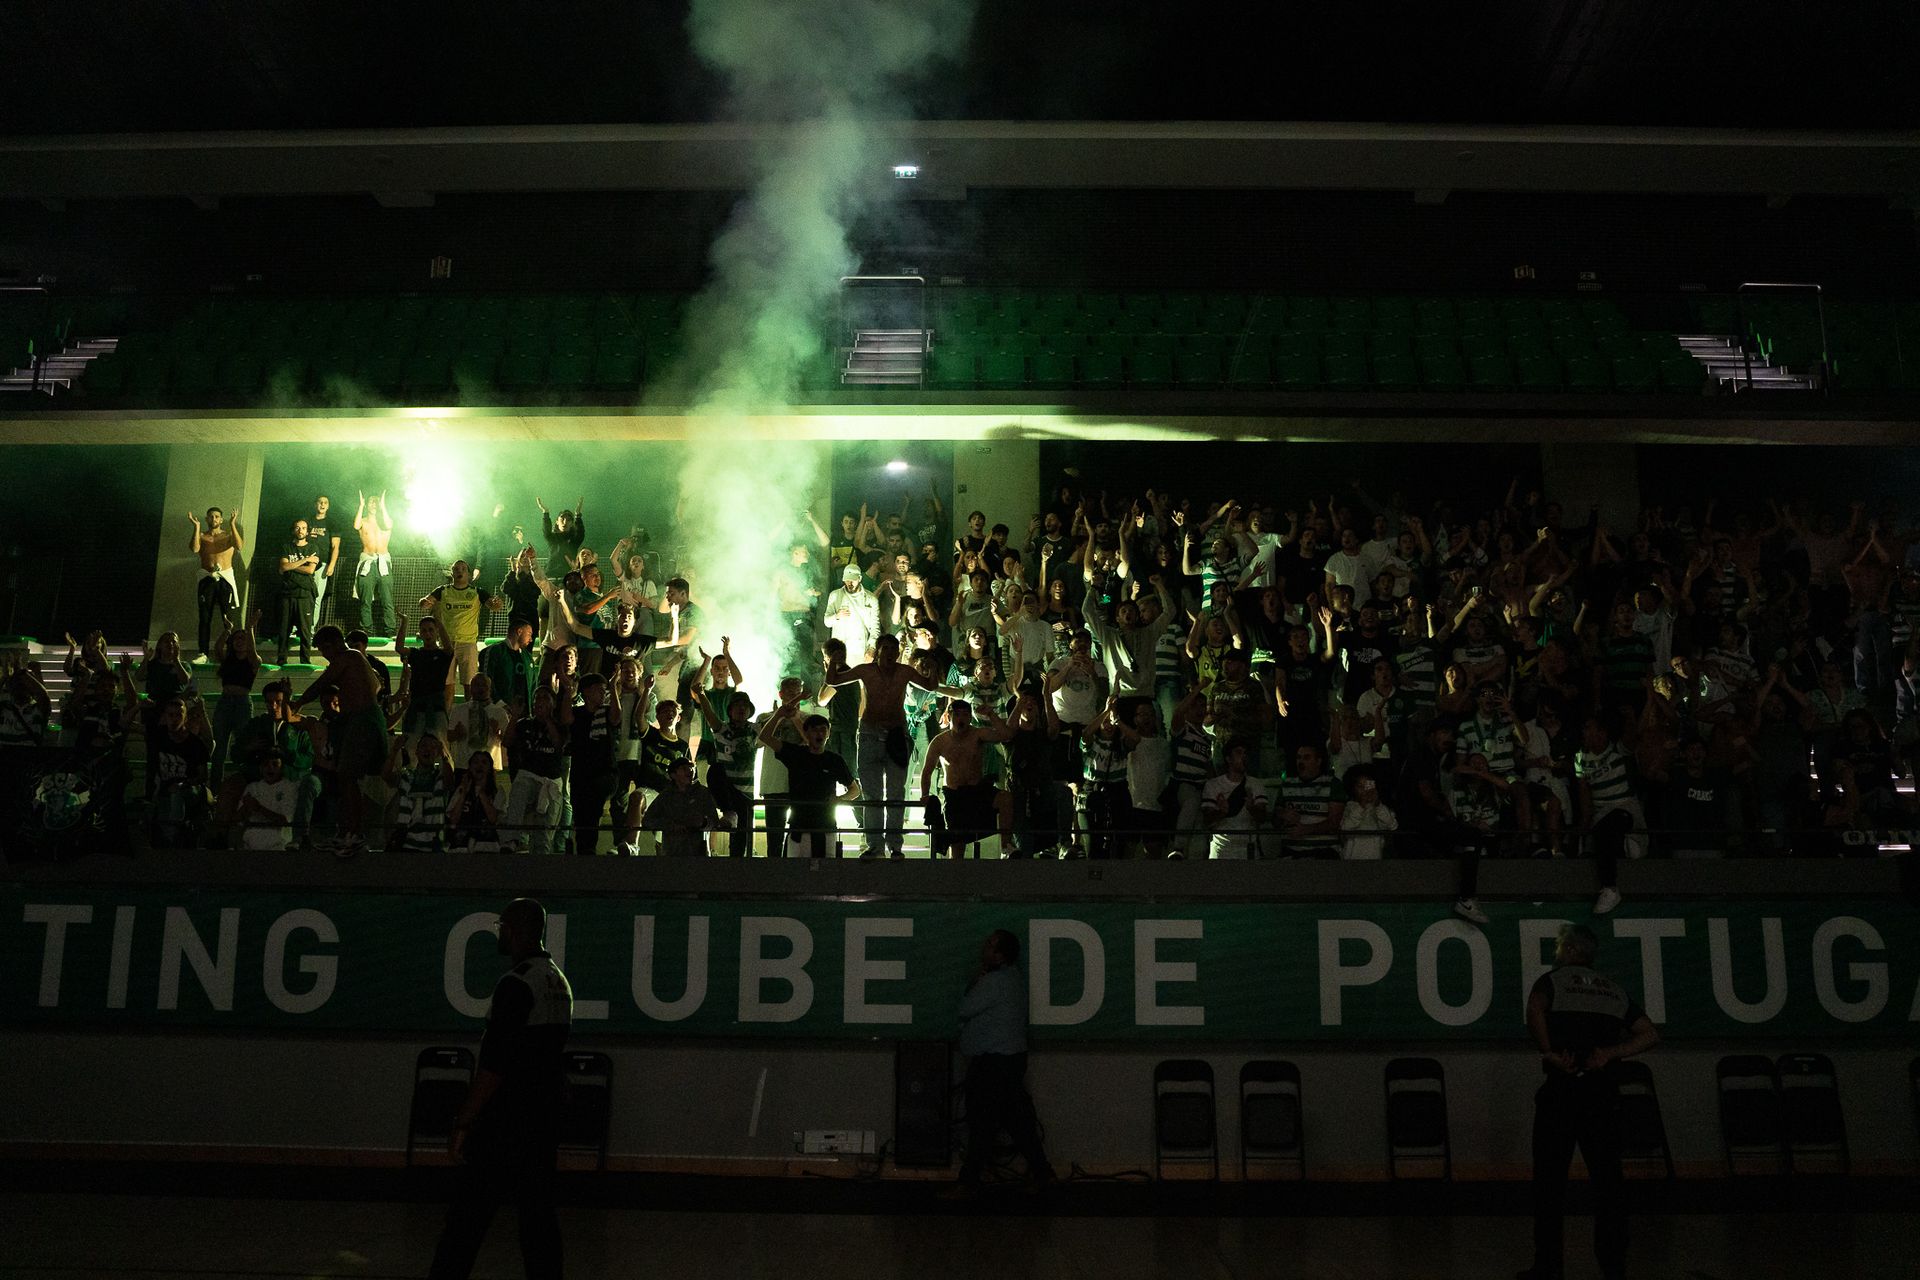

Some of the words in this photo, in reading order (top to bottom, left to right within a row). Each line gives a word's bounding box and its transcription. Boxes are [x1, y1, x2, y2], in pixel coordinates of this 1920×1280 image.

[23, 903, 341, 1015] TING
[443, 911, 914, 1024] CLUBE
[1029, 918, 1206, 1026] DE
